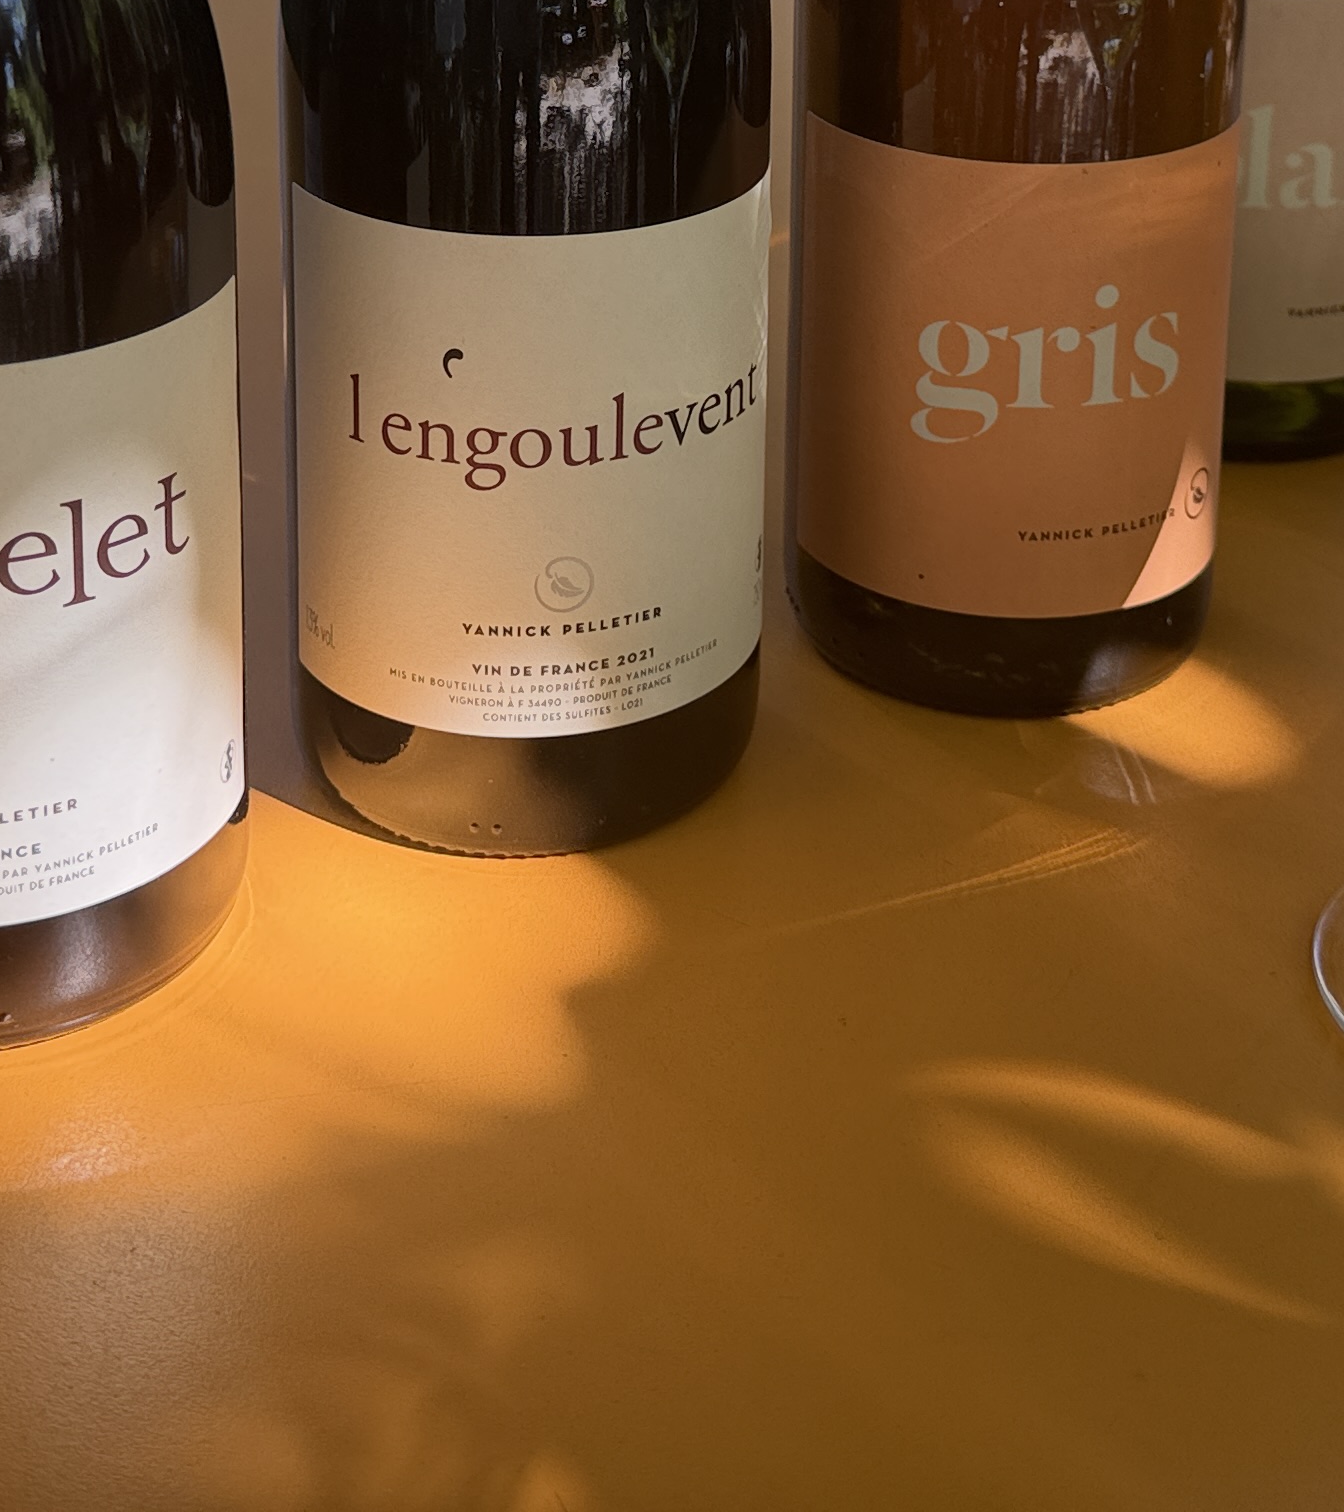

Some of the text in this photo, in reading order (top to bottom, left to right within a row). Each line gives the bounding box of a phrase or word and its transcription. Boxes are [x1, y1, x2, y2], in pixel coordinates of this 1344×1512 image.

[910, 284, 1179, 444] gris
[1018, 508, 1175, 542] YANNICK PELLETIER
[462, 606, 662, 637] YANNICK PELLETIER
[389, 638, 718, 694] MIS EN BOUTEILLE À LA PROPRIÉTÉ PAR YANNICK PELLETIER
[472, 647, 655, 677] VIN DE FRANCE 2021
[448, 674, 672, 708] VIGNERON À F 34490 PRODUIT DE FRANCE
[482, 712, 537, 723] CONTIENT
[541, 712, 562, 722] DES
[565, 705, 611, 720] SULFITES
[2, 866, 28, 880] PAR
[34, 850, 95, 873] YANNICK
[99, 822, 159, 857] PELLETIER
[29, 879, 45, 891] DE
[49, 866, 95, 886] FRANCE
